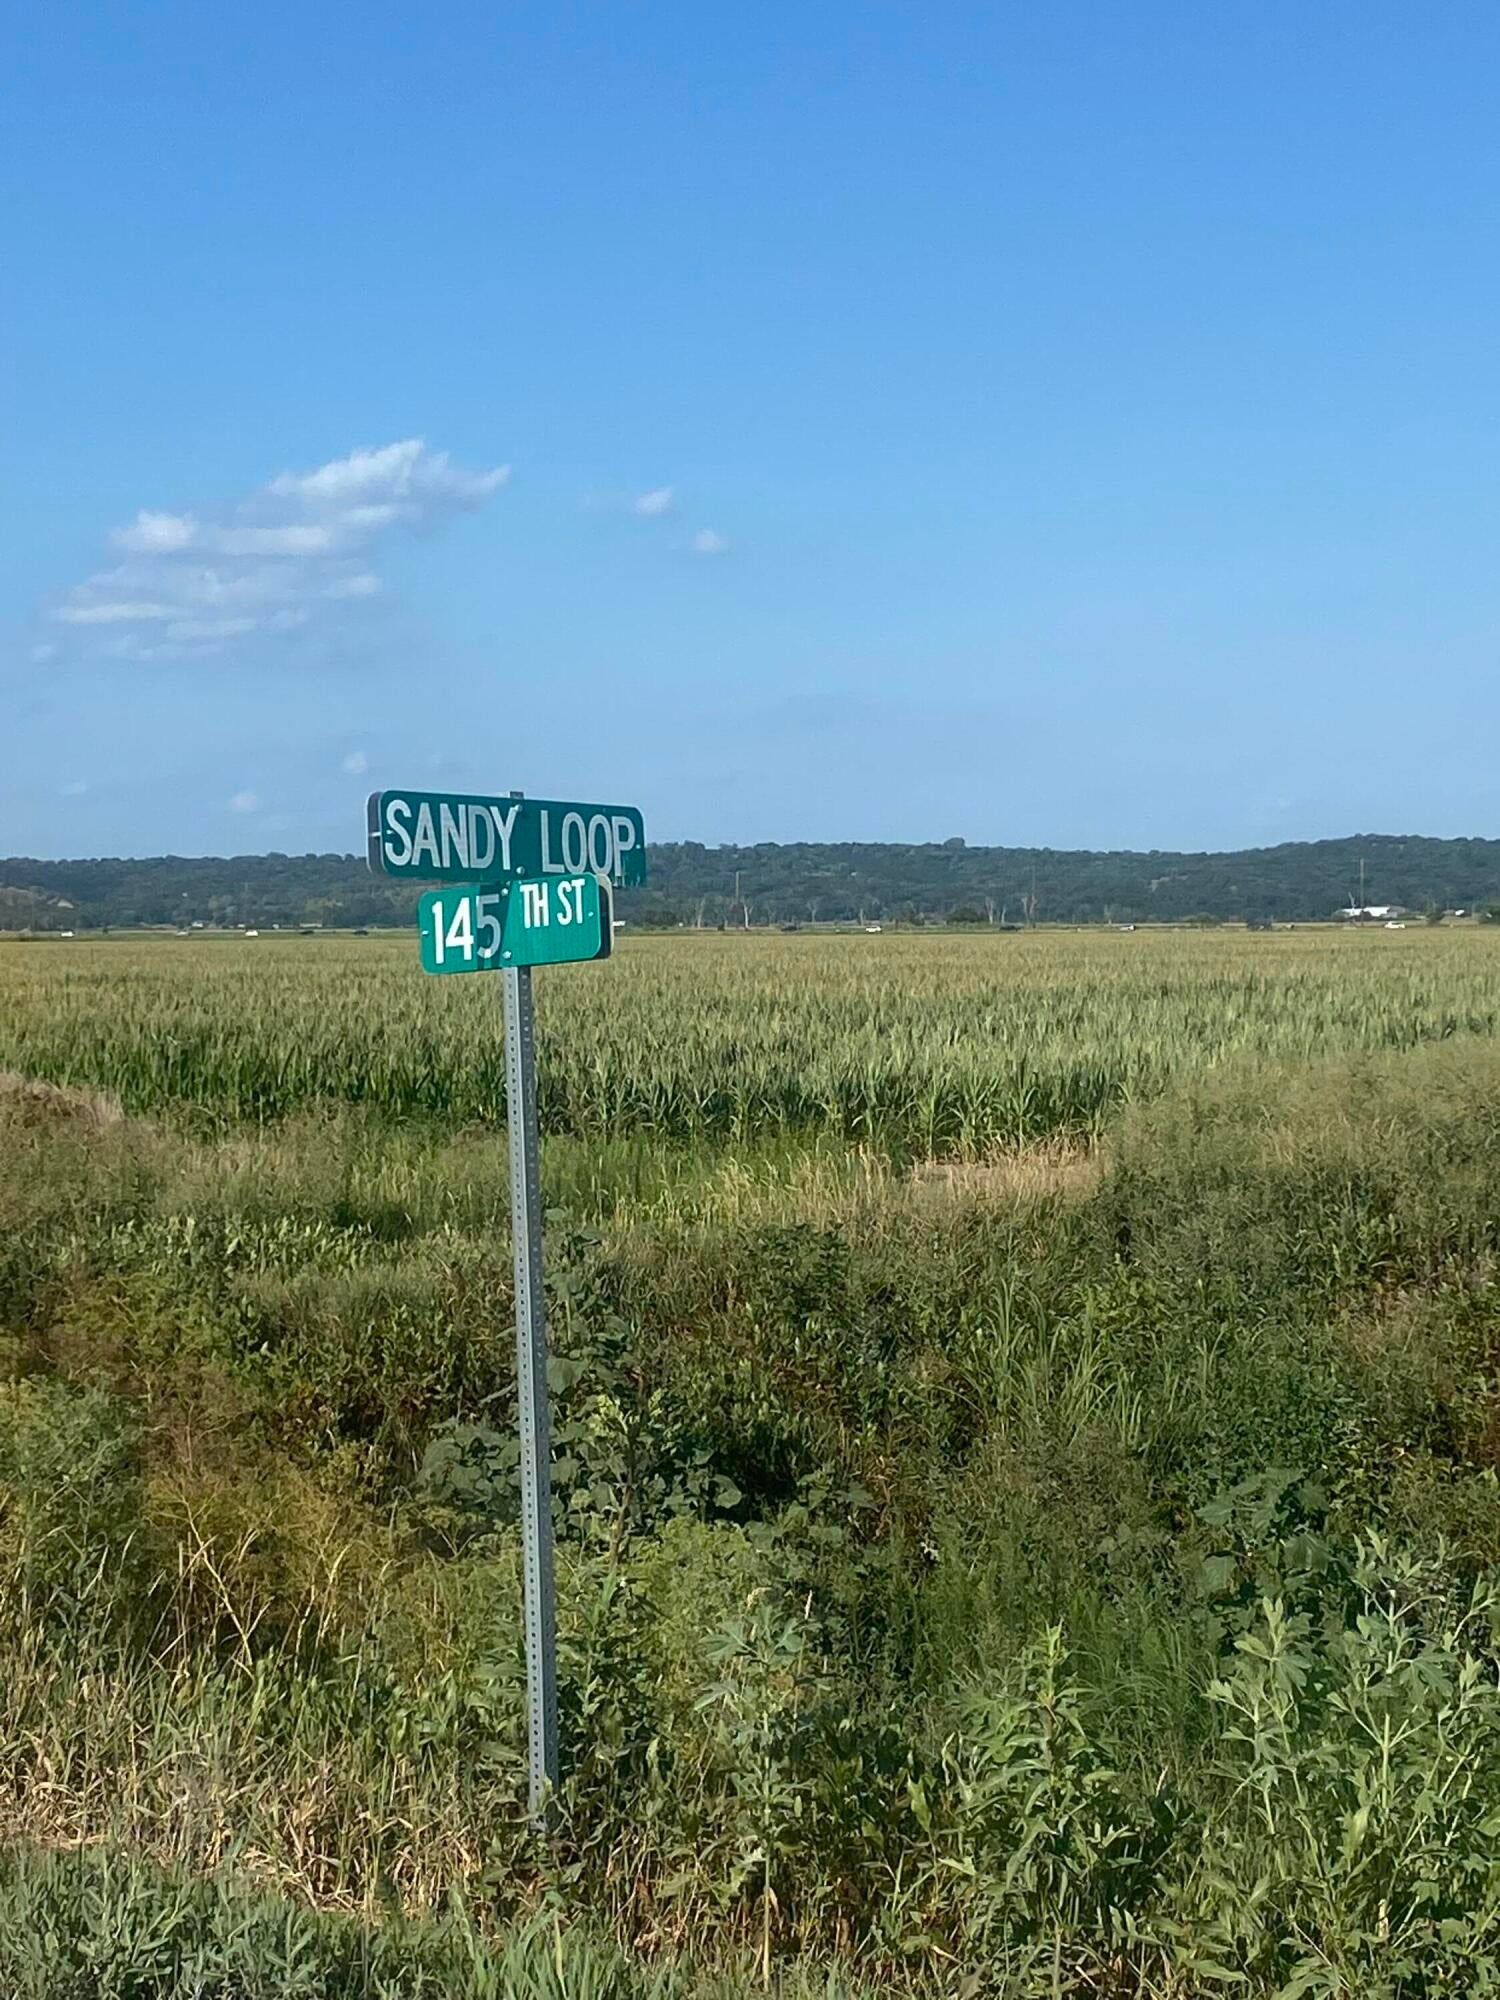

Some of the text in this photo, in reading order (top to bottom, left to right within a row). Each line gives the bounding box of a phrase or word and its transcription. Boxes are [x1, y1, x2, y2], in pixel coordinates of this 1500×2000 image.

[385, 799, 635, 877] SANDY LOOP
[432, 878, 586, 964] 145 TH ST
